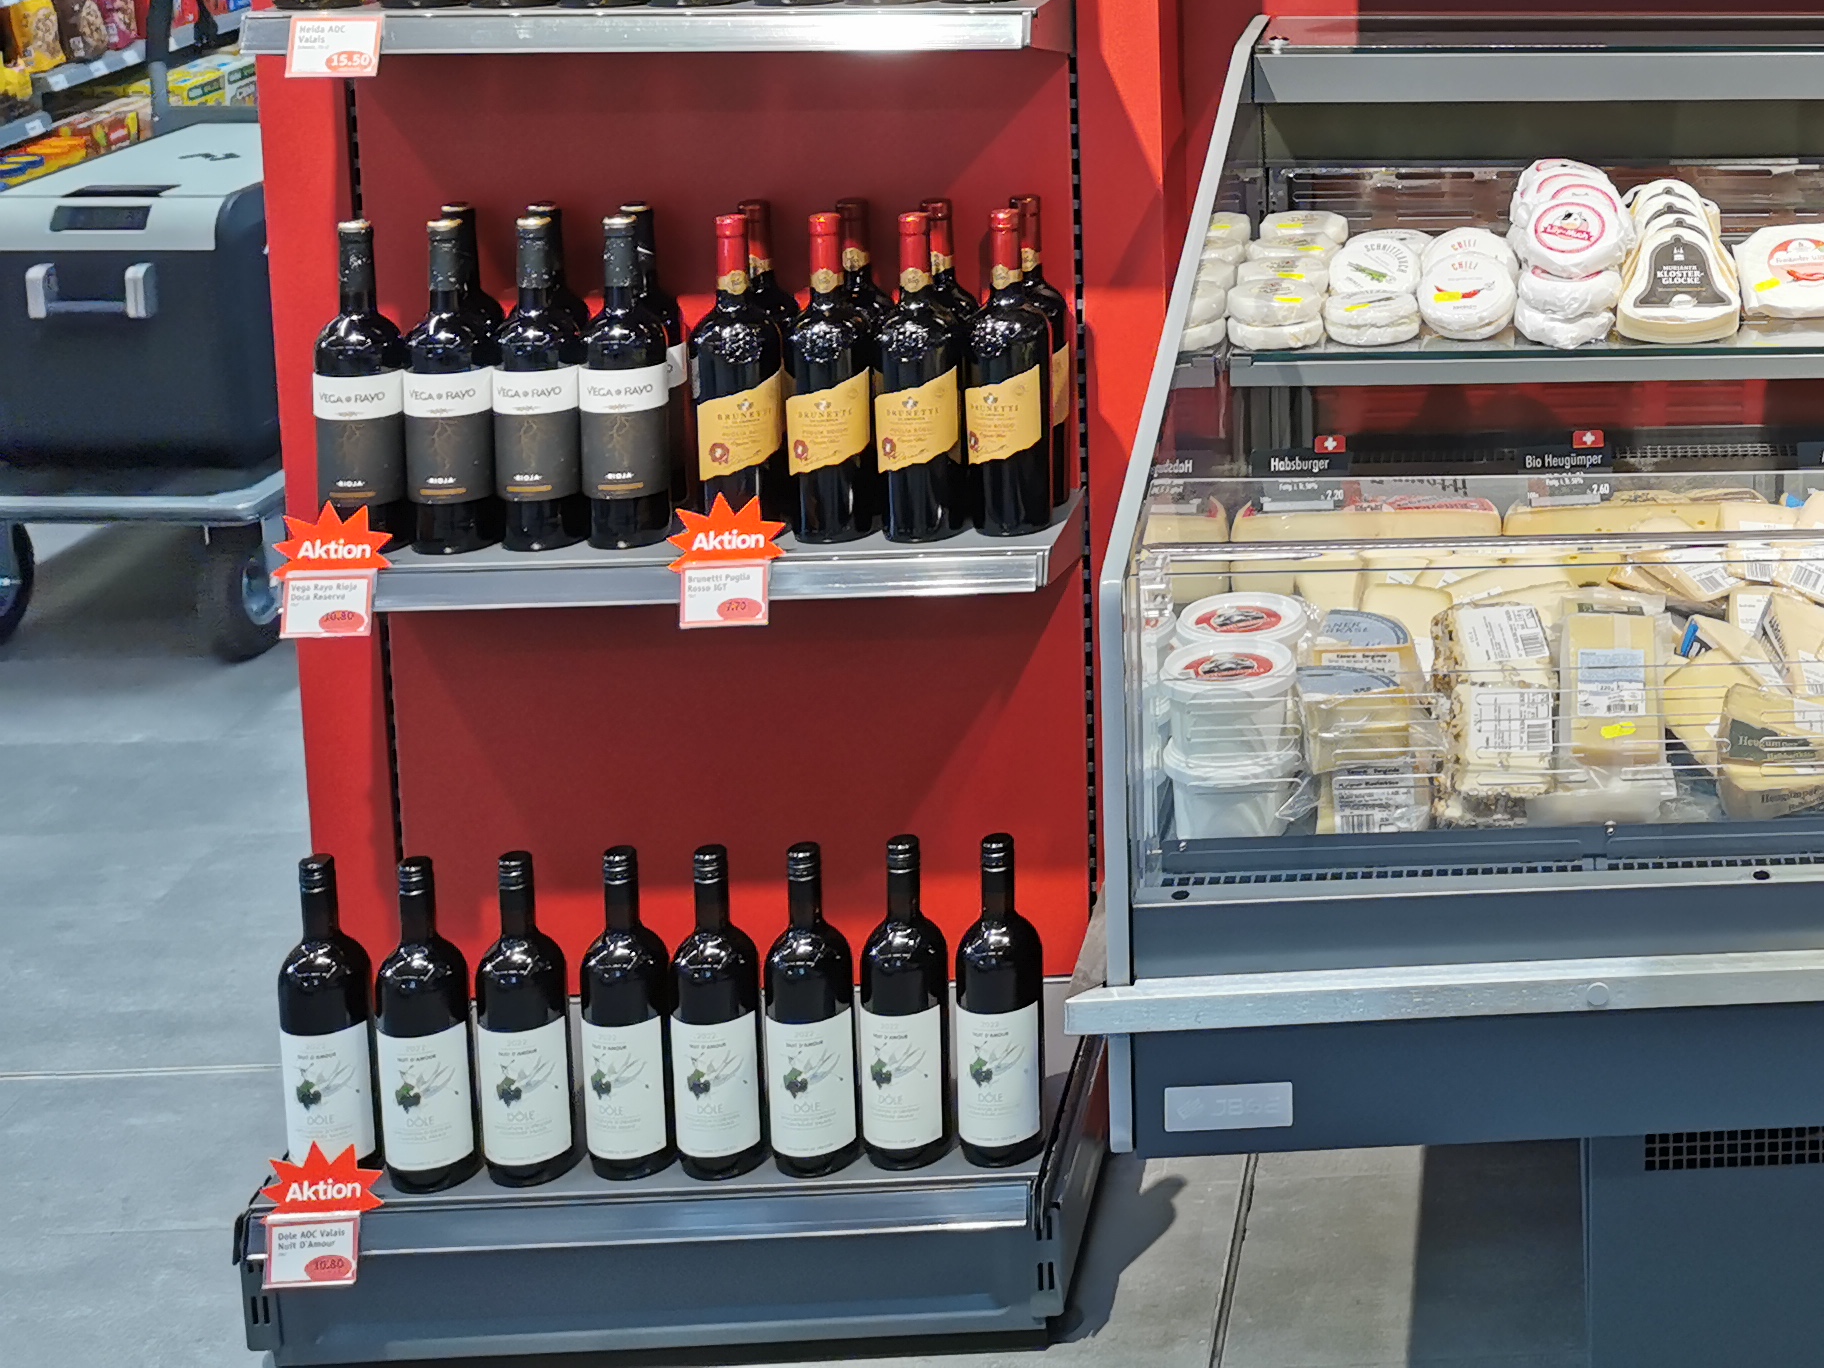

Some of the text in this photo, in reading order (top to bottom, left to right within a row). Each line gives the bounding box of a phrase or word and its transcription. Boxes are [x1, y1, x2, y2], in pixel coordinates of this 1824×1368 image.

[298, 35, 325, 44] Valais
[331, 53, 371, 67] 15.50
[1450, 238, 1479, 252] CHILI
[1450, 261, 1480, 273] CHILI
[1656, 270, 1705, 280] KLOSTER-
[1661, 277, 1702, 286] GLOCKE
[409, 387, 477, 402] VEGA RAYO
[496, 385, 562, 399] VEGA RAYO
[586, 383, 655, 398] VEGA RAYO
[319, 390, 386, 404] VEGA RAYO
[1270, 455, 1330, 473] Habsburger
[1525, 453, 1603, 470] Bio Heugümper
[604, 470, 635, 481] RIOJA
[1325, 488, 1345, 501] 2.20
[1591, 483, 1610, 495] 2.60
[690, 528, 766, 552] Aktion
[296, 538, 373, 560] Aktion
[688, 572, 751, 584] Brunetti Puglia
[291, 582, 358, 594] Vega Rayo Rioja
[688, 583, 728, 593] Rosso IGT
[291, 593, 346, 602] Doca Reserva
[696, 1103, 724, 1115] DÔLE
[793, 1101, 820, 1114] DÔLE
[285, 1177, 363, 1203] Aktion
[300, 1229, 346, 1239] AOC Valais
[278, 1241, 297, 1251] Nuit
